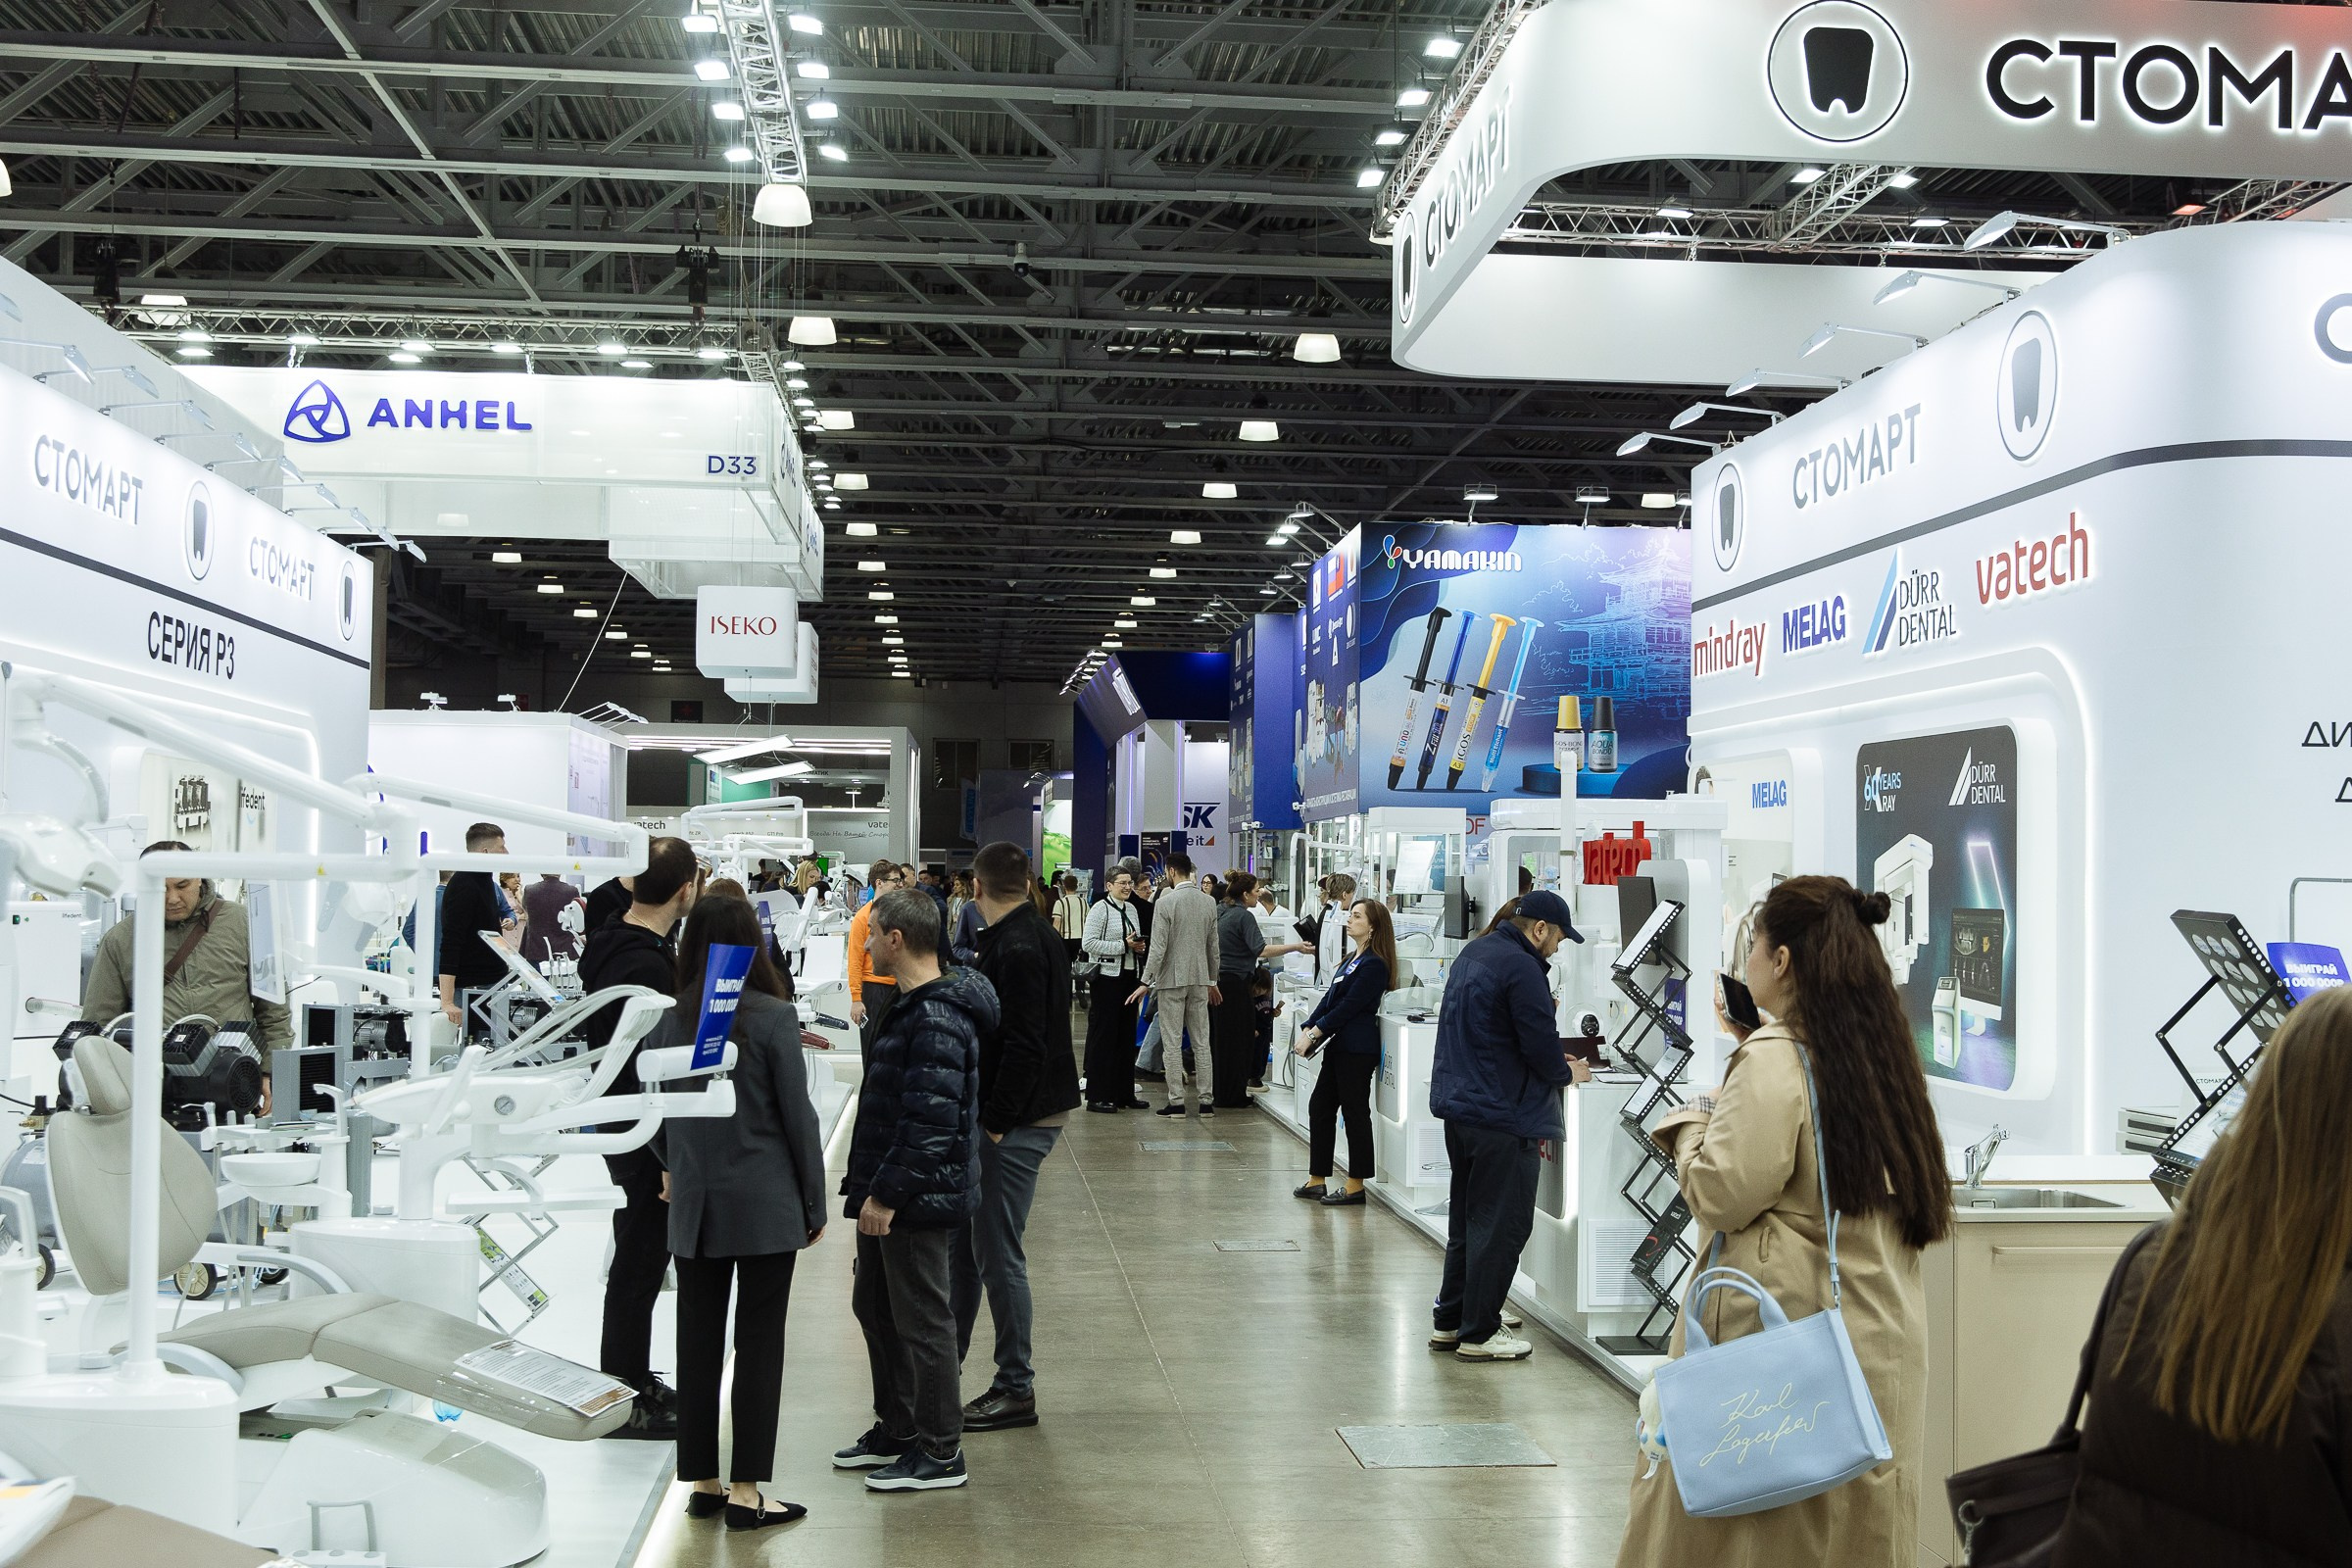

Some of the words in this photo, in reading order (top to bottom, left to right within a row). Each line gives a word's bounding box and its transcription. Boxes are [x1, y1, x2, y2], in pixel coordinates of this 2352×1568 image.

[1426, 84, 1511, 268] СТОМАРТ
[368, 398, 532, 431] ANHEL
[708, 456, 757, 475] D33
[1792, 403, 1921, 510] СТОМАРТ
[34, 434, 143, 525] СТОМАРТ
[249, 536, 315, 601] СТОМАРТ
[1402, 549, 1521, 571] YAMAKIN
[1976, 512, 2089, 606] vatech
[1899, 568, 1939, 610] DÜRR
[710, 615, 777, 636] ISEKO
[1783, 594, 1846, 655] MELAG
[1899, 603, 1956, 647] DENTAL
[148, 611, 212, 676] СЕРИЯ
[1693, 618, 1766, 677] mindray
[1864, 774, 1879, 802] 60
[1879, 772, 1901, 790] YEARS
[1972, 761, 1996, 783] DÜRR
[1751, 780, 1787, 808] MELAG
[1972, 785, 2006, 805] DENTAL
[715, 976, 745, 992] ВЫИГРАЙ
[2285, 963, 2338, 975] ВЫИГРАЙ
[2292, 977, 2316, 987] 000
